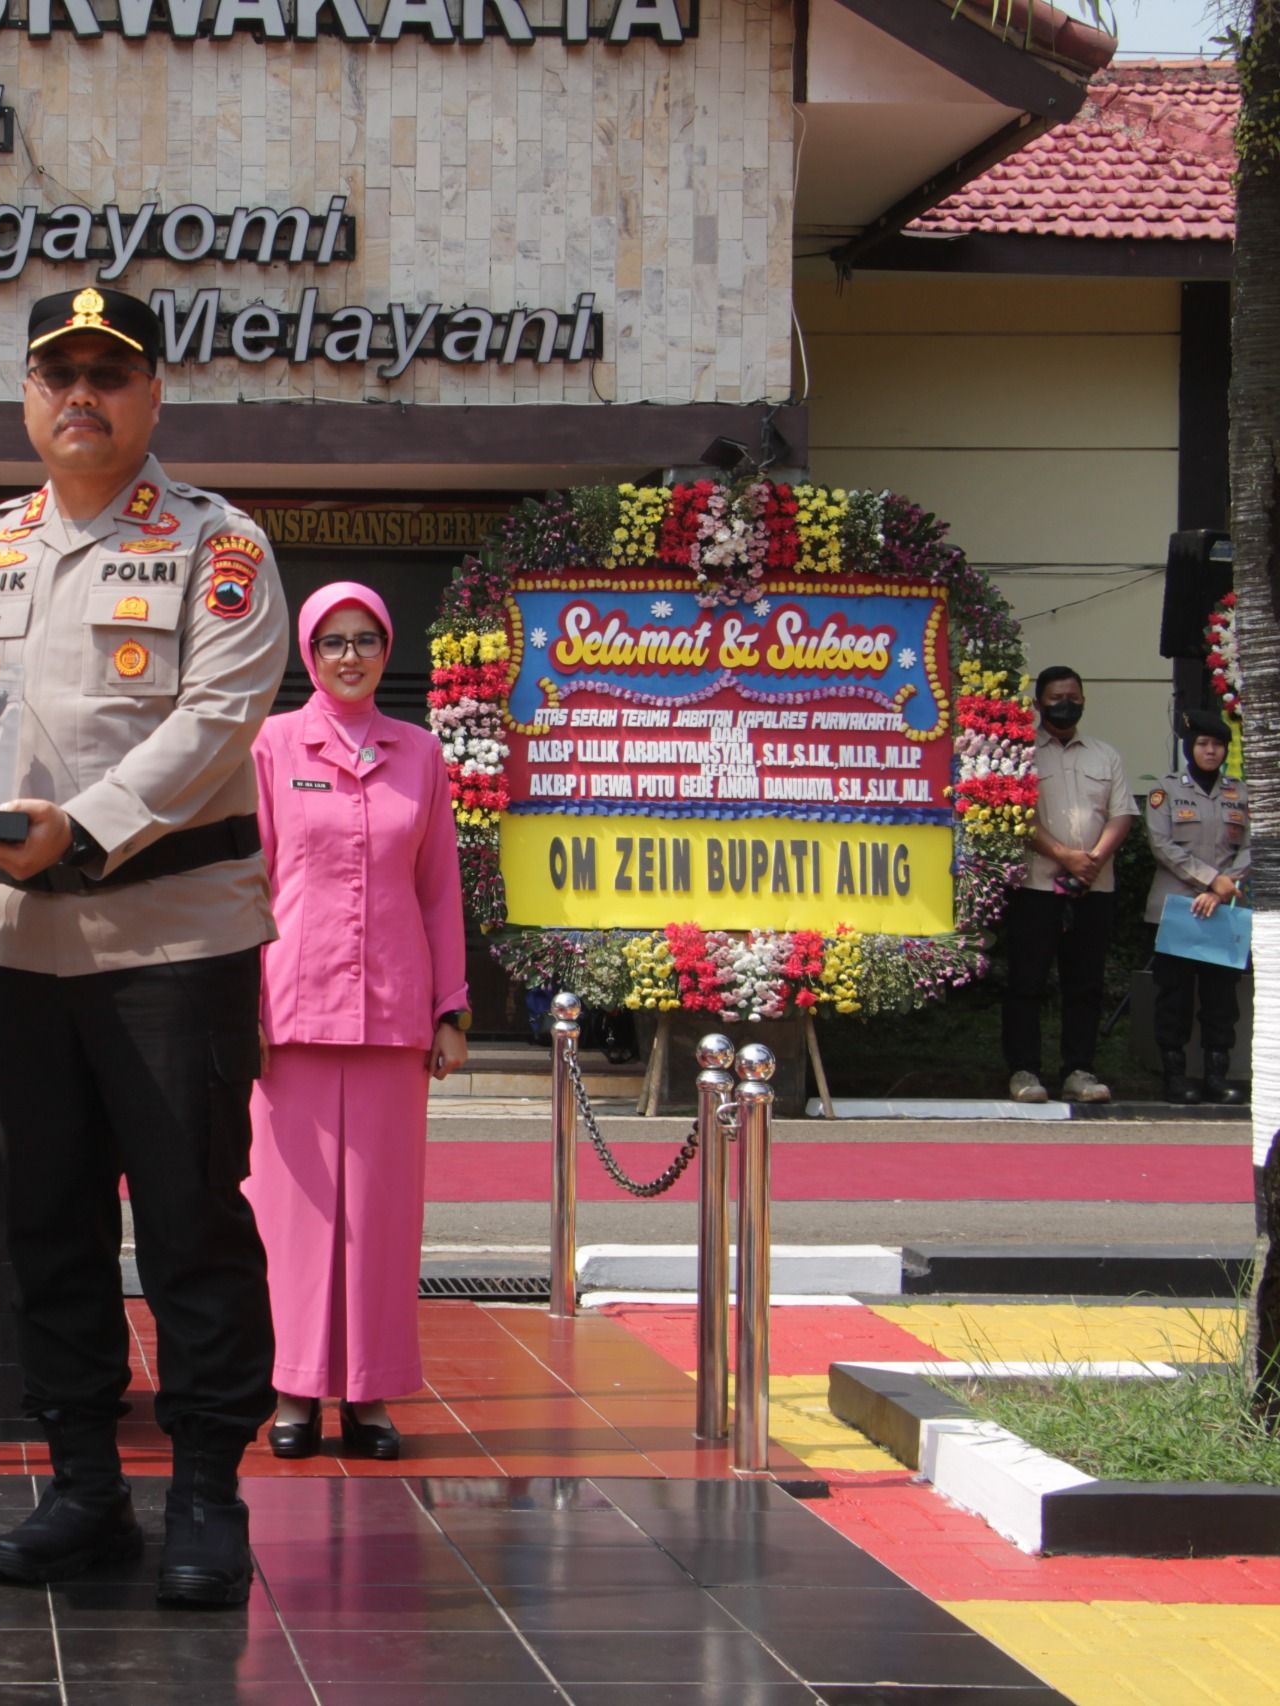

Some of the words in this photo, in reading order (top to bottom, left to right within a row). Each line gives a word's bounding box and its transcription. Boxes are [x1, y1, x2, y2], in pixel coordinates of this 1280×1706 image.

[151, 287, 596, 380] Melayani
[253, 508, 413, 544] ANSPARANSI
[102, 561, 176, 582] POLRI
[556, 606, 712, 667] Selamat
[719, 618, 759, 667] &
[767, 610, 891, 670] Sukses
[534, 709, 568, 726] ATAS
[570, 709, 618, 727] SERAH
[621, 709, 670, 728] TERIMA
[672, 710, 733, 728] JABATAN
[737, 711, 808, 729] KAPOLRES
[812, 712, 903, 731] PURWAKARTA
[710, 727, 748, 743] DARI
[528, 740, 574, 763] AKBP
[577, 740, 619, 763] LILIK
[701, 764, 757, 778] KEPADA
[529, 774, 576, 796] AKBP
[580, 775, 586, 797] I
[591, 775, 633, 797] DEWA
[638, 775, 675, 798] PUTU
[680, 775, 714, 798] GEDE
[718, 776, 759, 799] ANOM
[549, 837, 596, 890] OM
[615, 837, 690, 891] ZEIN
[707, 838, 819, 893] BUPATI
[837, 841, 910, 896] AING
